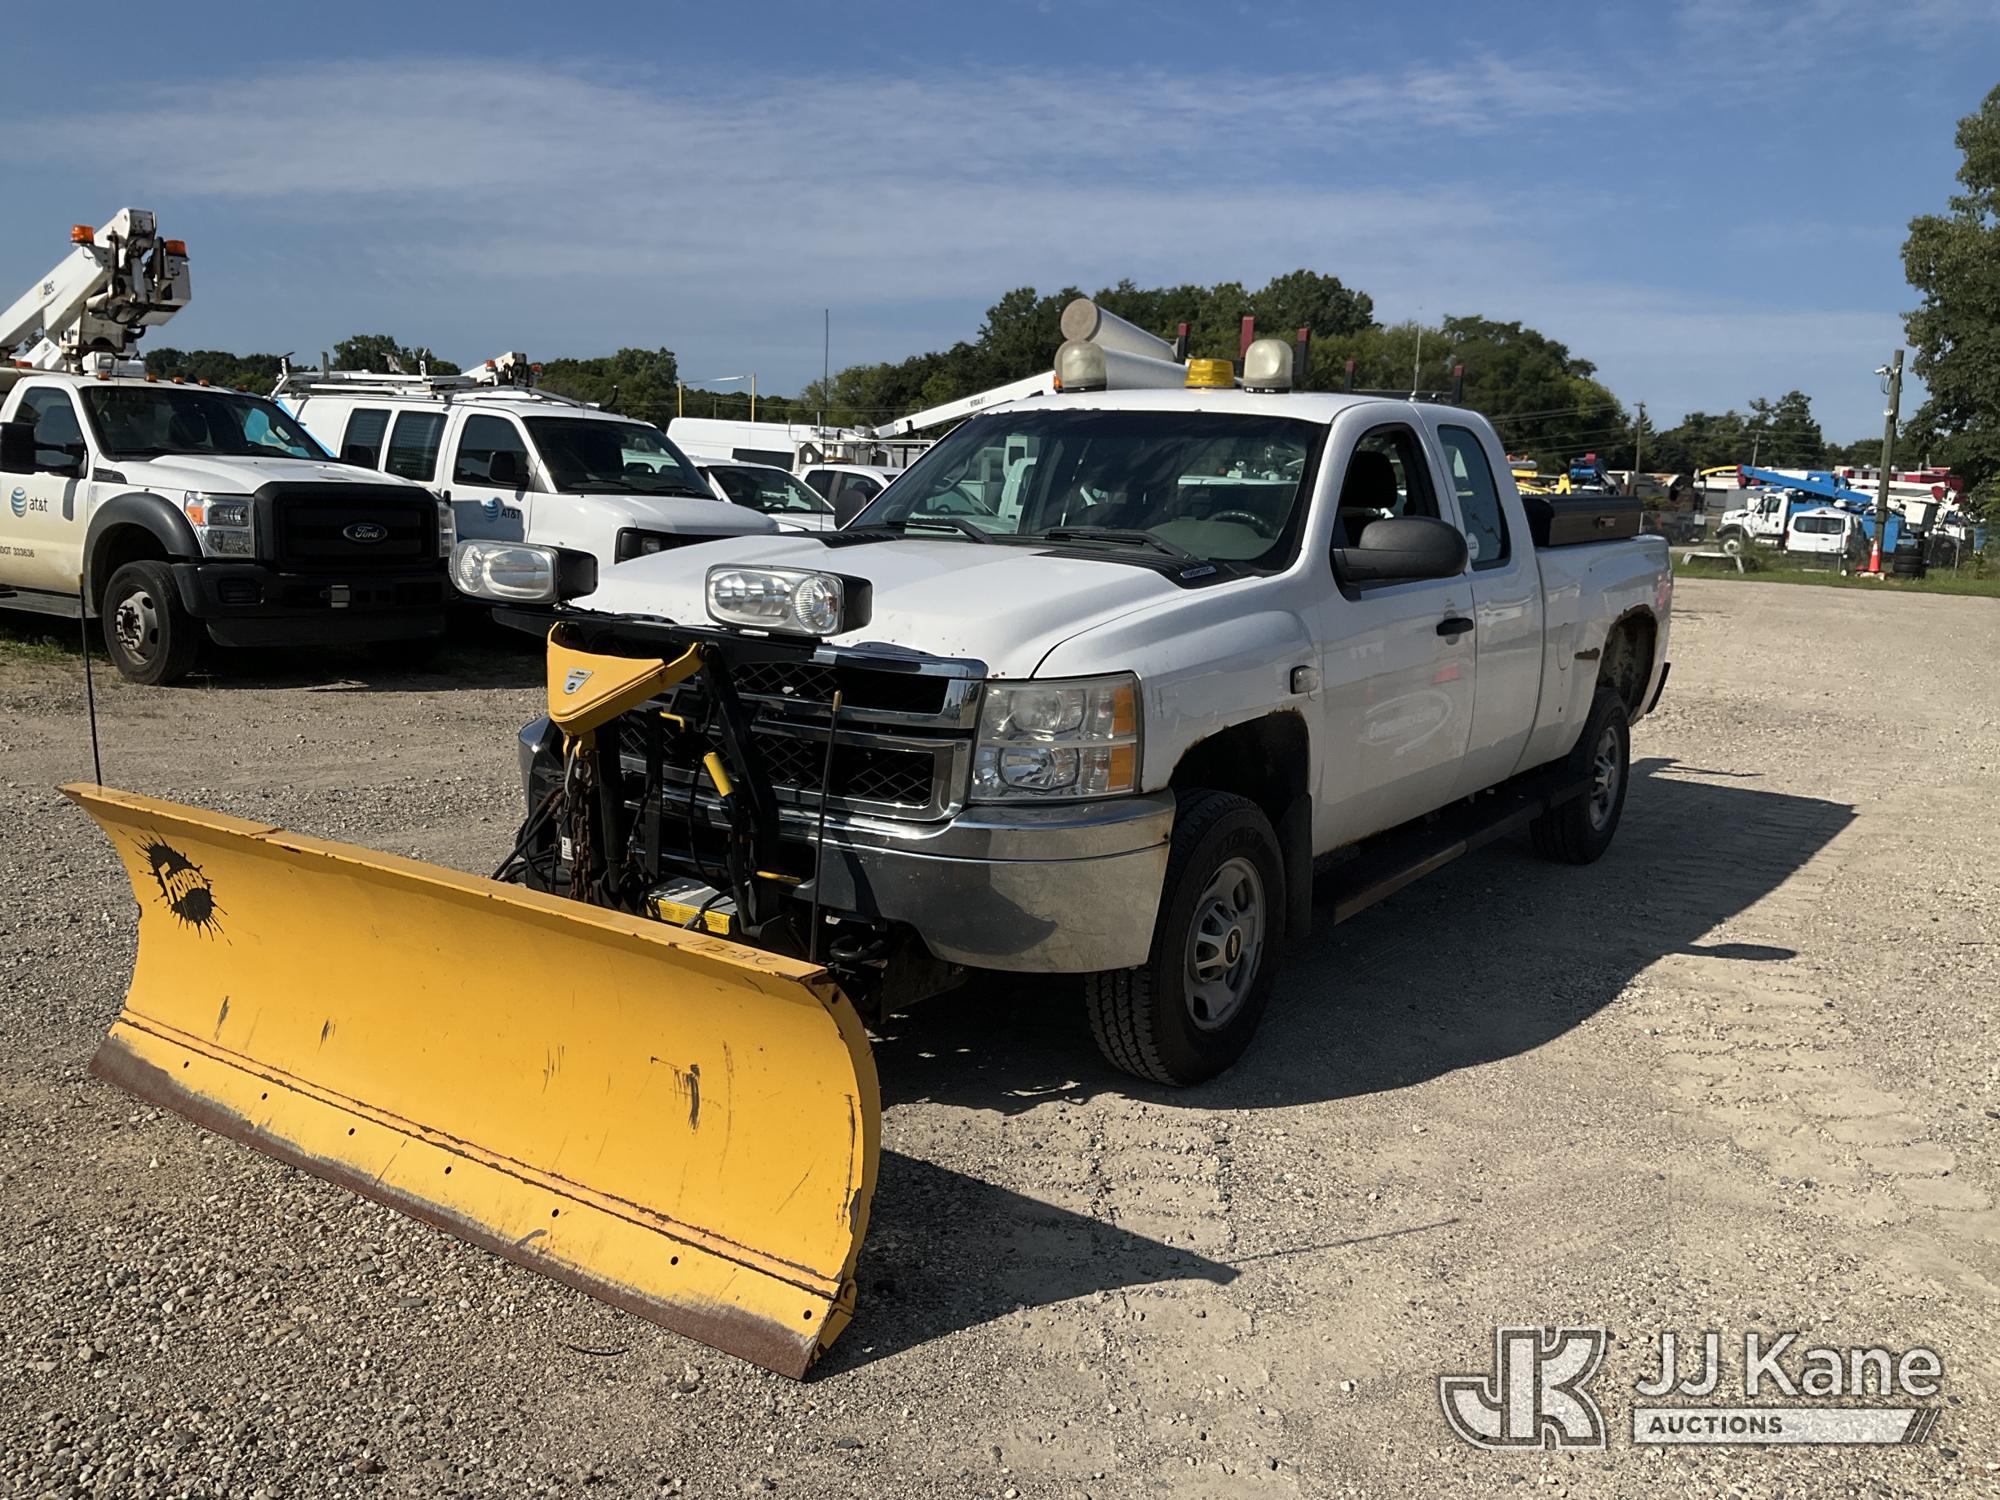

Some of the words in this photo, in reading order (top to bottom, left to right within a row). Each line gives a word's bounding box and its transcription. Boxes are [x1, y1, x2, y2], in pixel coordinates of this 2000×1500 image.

[29, 497, 48, 512] at&t
[501, 508, 521, 520] AT&T
[354, 525, 380, 538] Ford
[158, 861, 208, 905] FISHER
